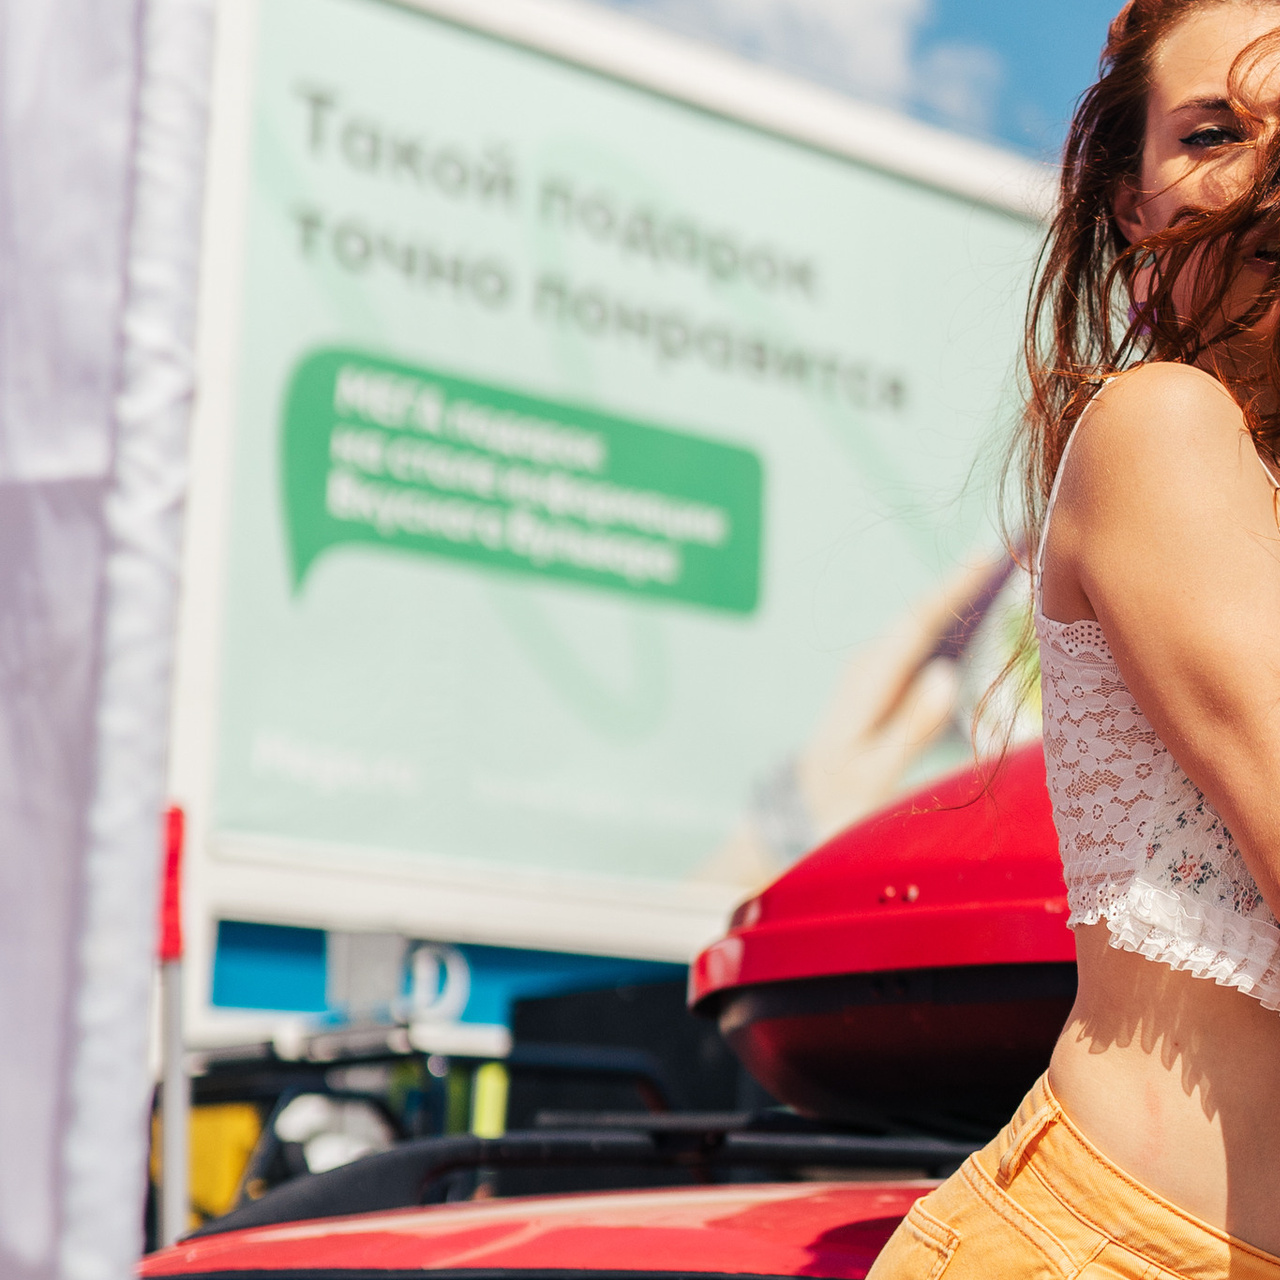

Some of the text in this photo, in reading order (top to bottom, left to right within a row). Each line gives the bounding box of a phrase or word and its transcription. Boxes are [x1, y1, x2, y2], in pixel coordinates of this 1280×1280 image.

[294, 80, 820, 300] Такой подарок
[294, 204, 908, 418] точно понравится
